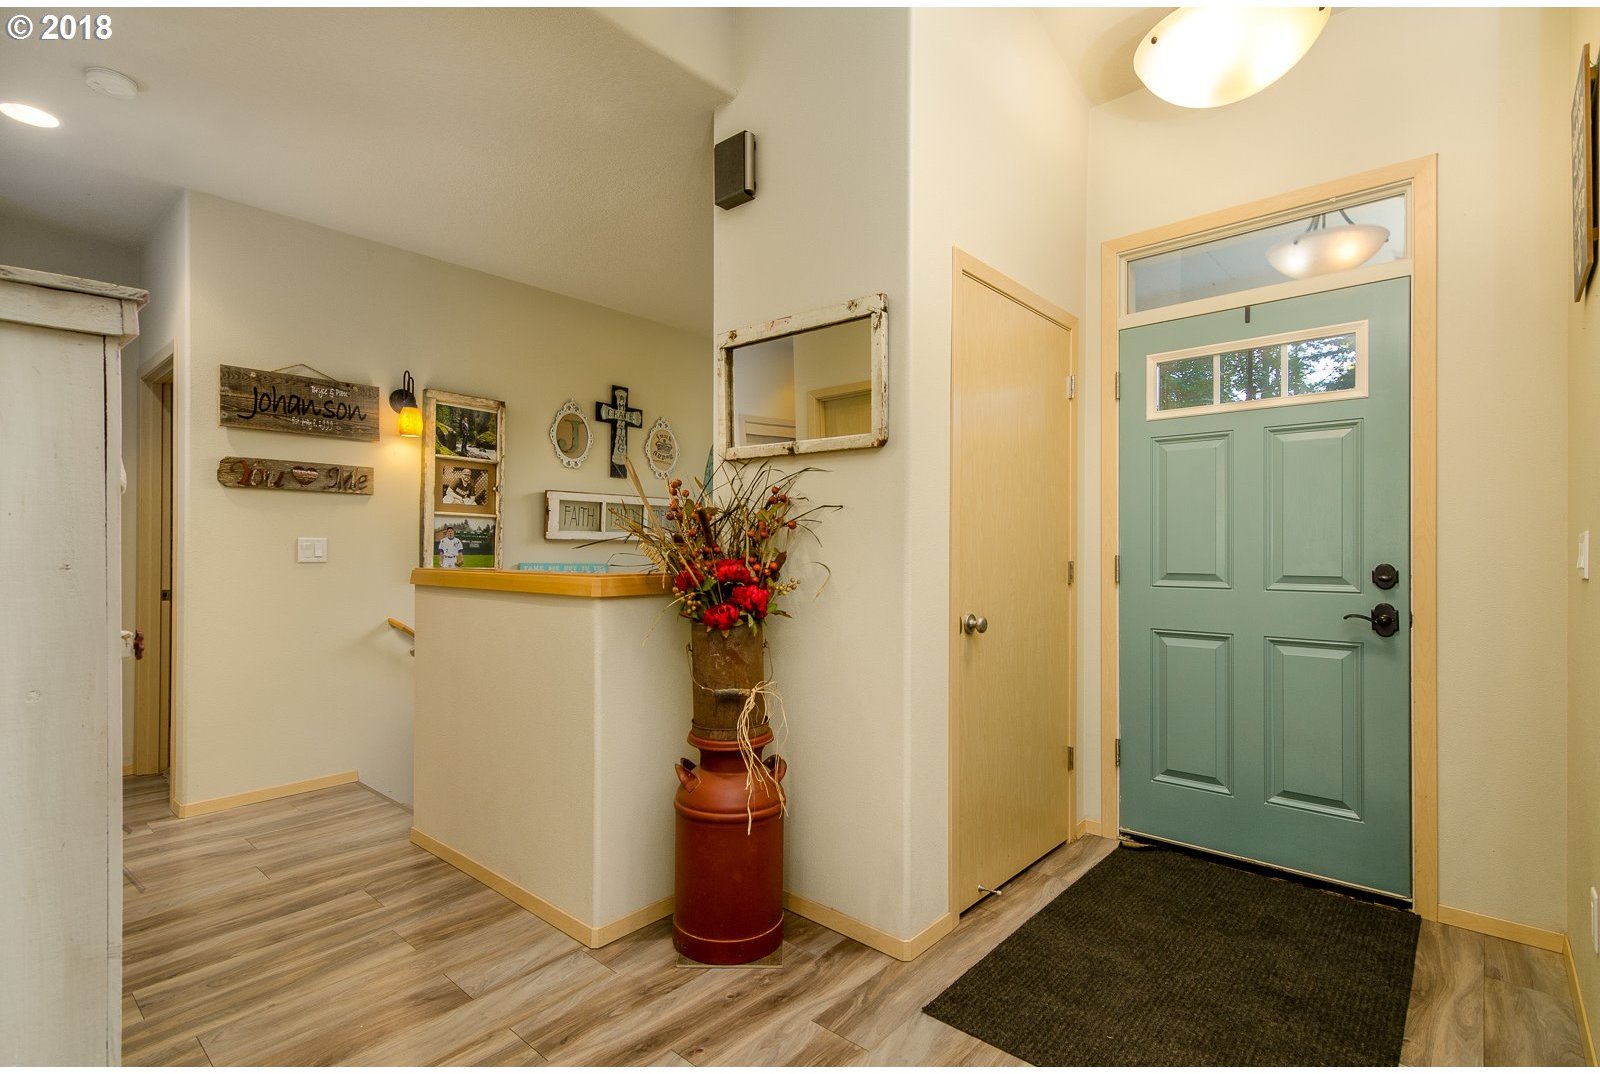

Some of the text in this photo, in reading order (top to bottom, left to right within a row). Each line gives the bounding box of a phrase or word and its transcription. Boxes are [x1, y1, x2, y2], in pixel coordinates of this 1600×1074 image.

[236, 385, 367, 421] Johanson
[230, 459, 368, 491] You Me
[564, 505, 595, 527] FAITH
